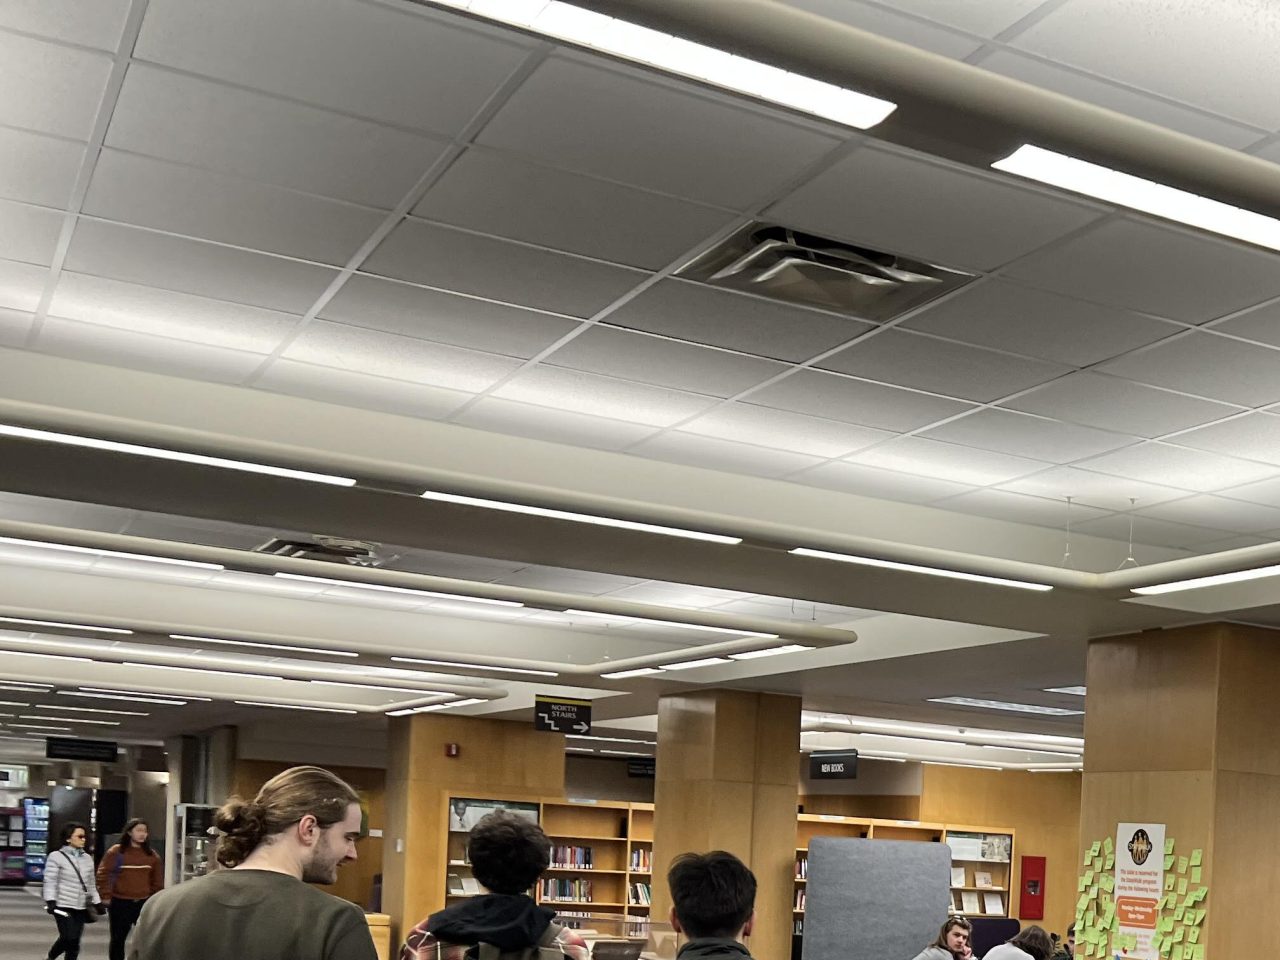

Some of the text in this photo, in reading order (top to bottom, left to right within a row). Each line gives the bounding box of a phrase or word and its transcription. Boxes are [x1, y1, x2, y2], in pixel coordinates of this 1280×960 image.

[552, 704, 577, 713] NORTH
[552, 711, 576, 719] STAIRS
[821, 763, 844, 773] NEW BOOKS
